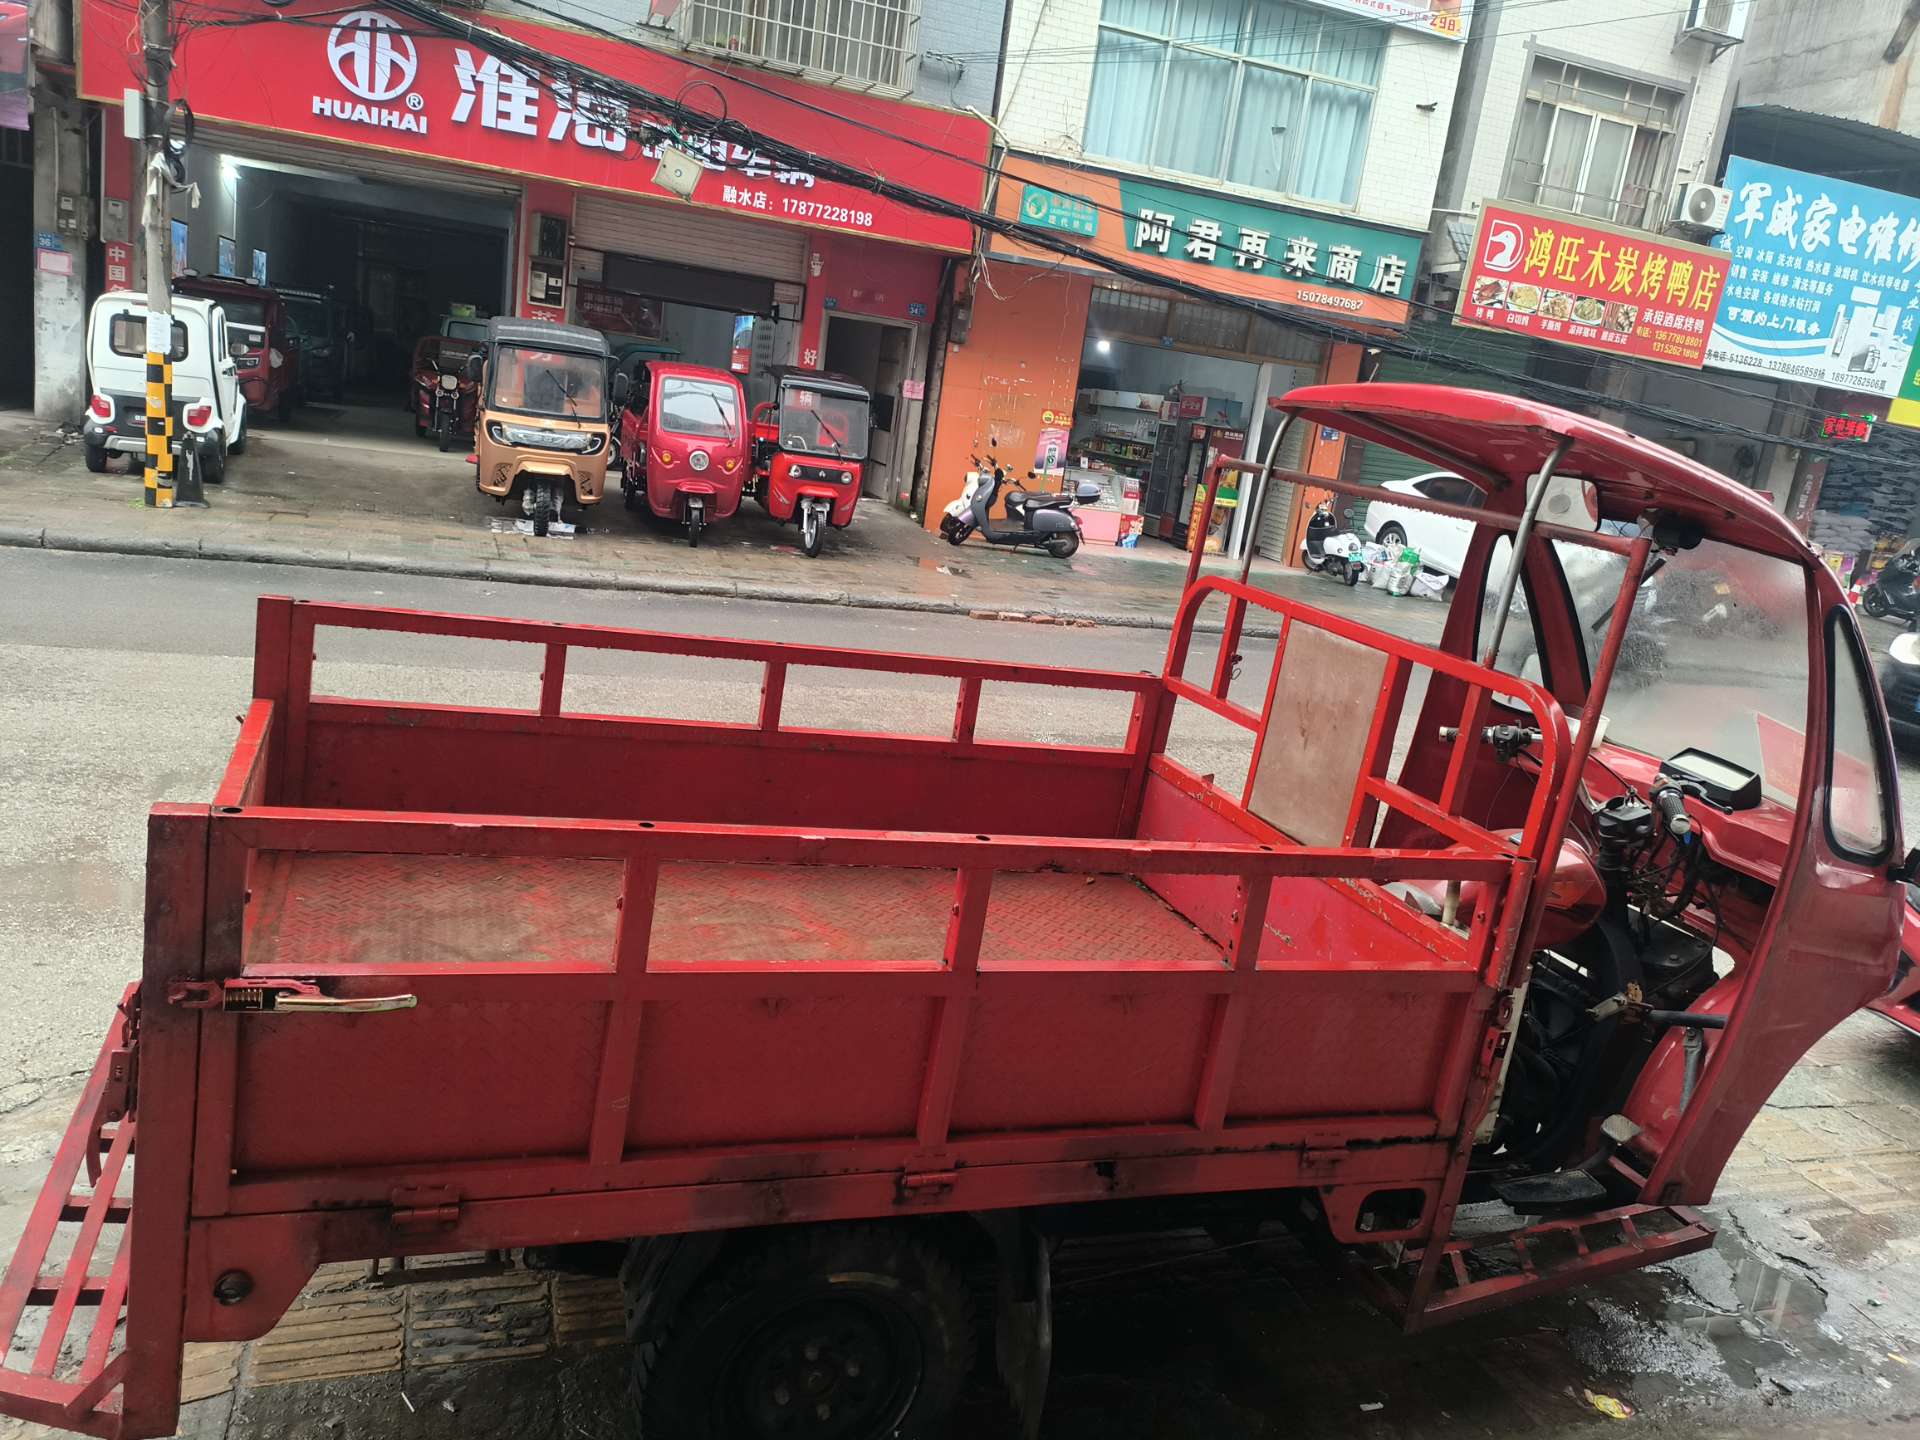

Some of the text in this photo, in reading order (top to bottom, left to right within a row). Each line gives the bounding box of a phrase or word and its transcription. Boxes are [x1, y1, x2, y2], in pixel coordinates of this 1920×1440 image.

[312, 95, 428, 134] HUAIHAI
[782, 198, 874, 227] 17877228198
[1134, 208, 1408, 295] 阿君再来商店
[1524, 226, 1721, 312] 鸿旺木炭烤鸭店
[1641, 308, 1704, 334] 承接酒席烤鸭
[803, 348, 818, 366] 好
